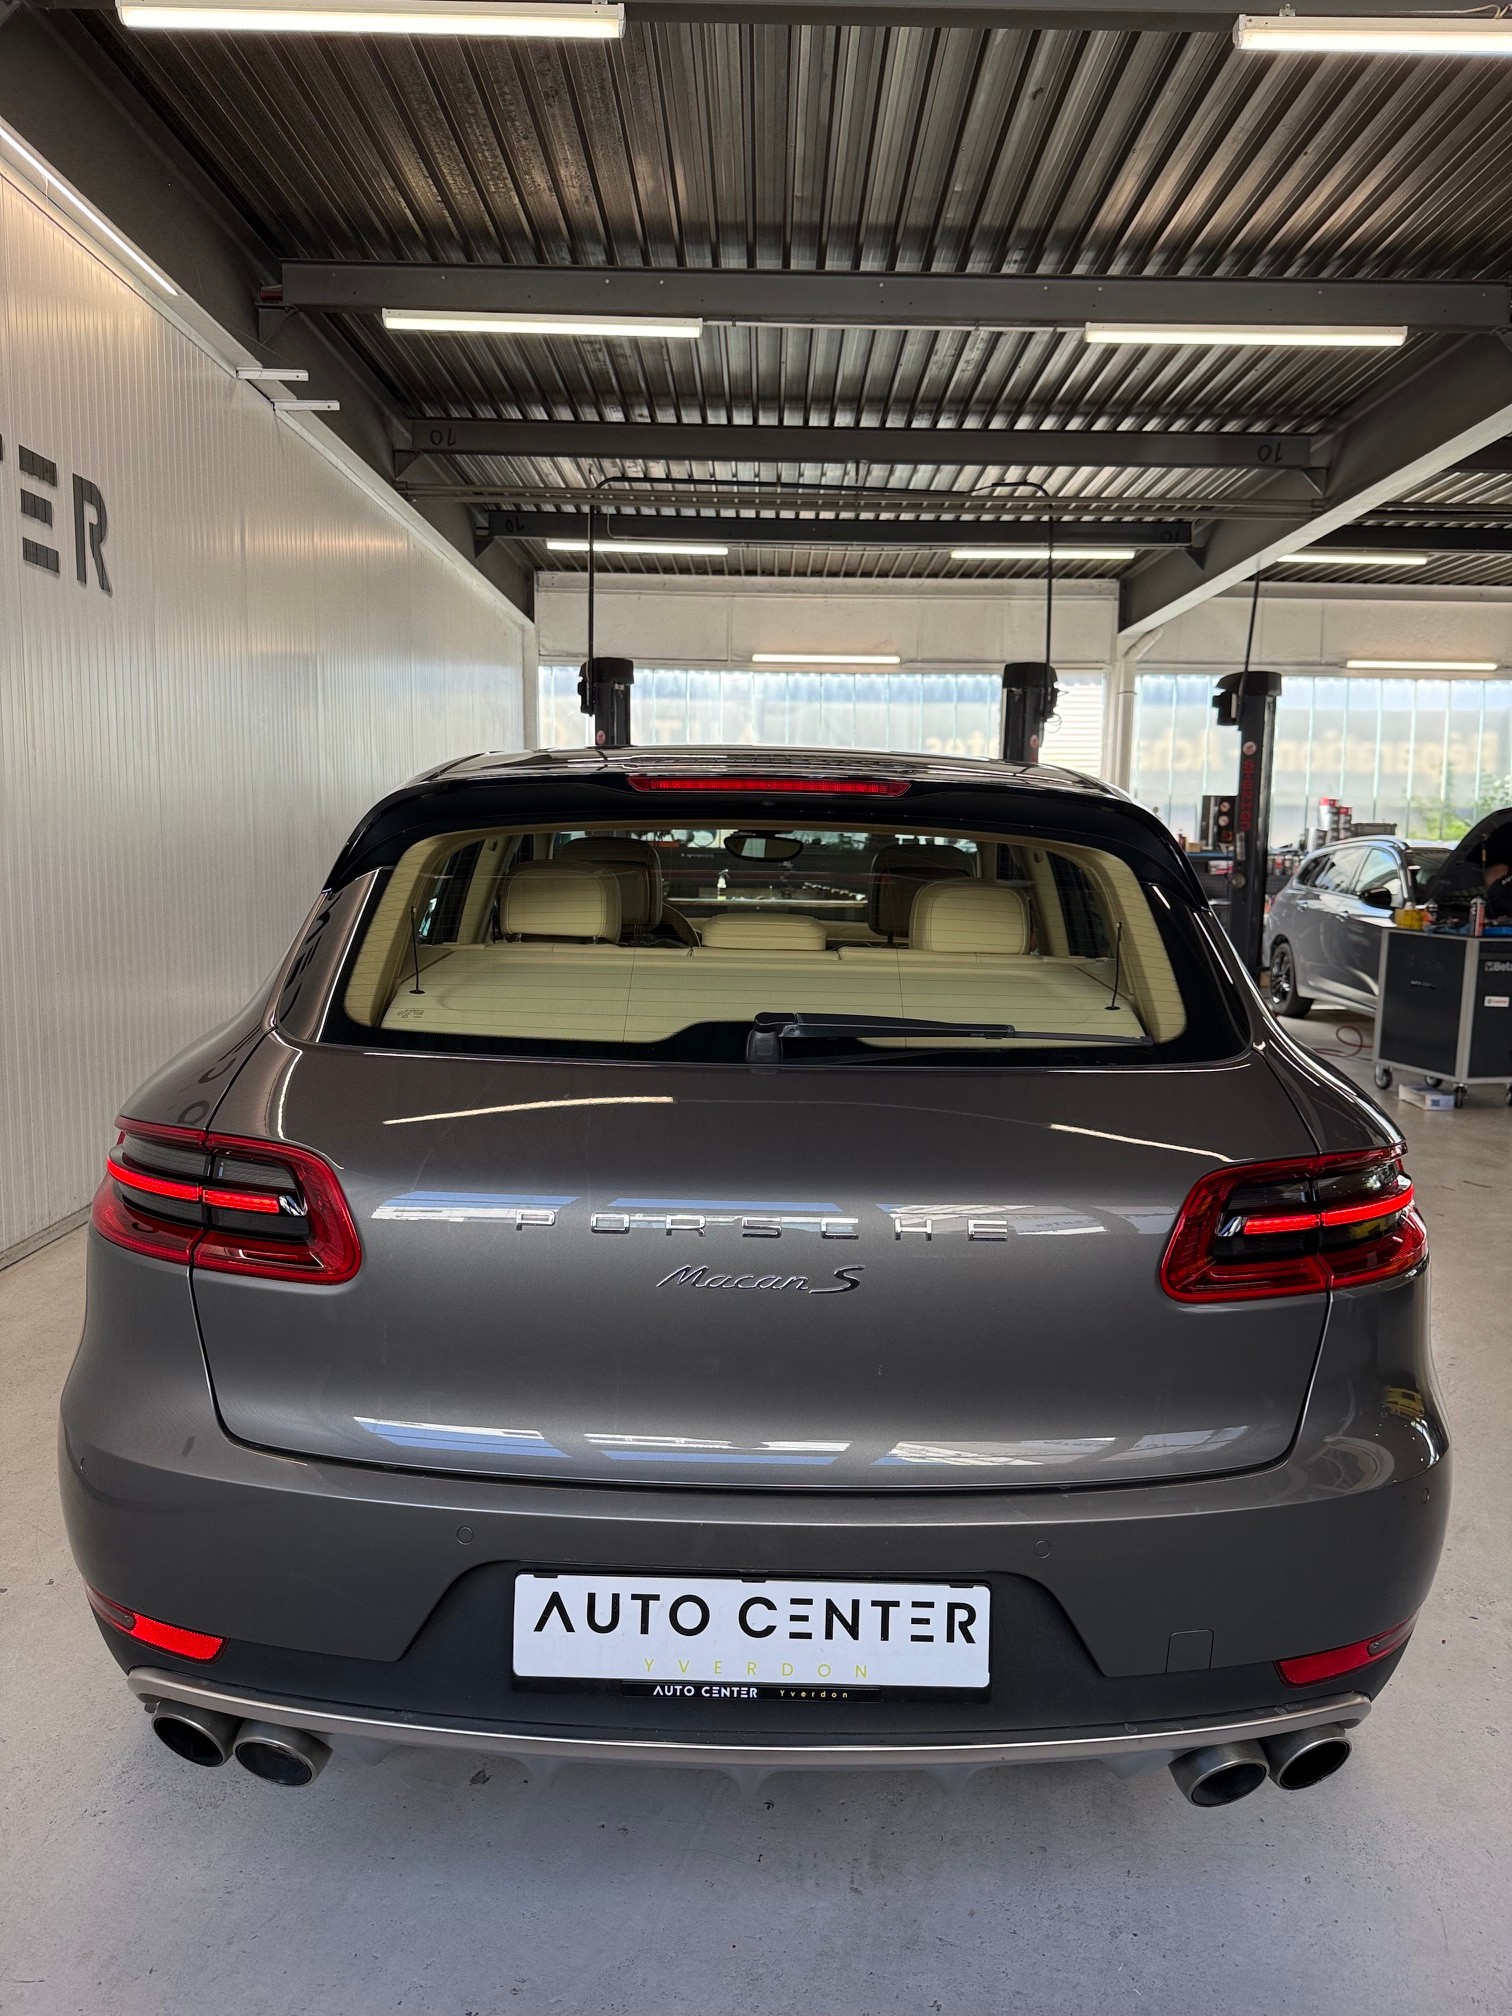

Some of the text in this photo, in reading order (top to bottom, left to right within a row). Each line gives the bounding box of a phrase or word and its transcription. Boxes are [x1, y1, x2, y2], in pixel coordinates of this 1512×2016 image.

[0, 433, 111, 592] ER
[515, 1209, 1008, 1242] PORSCHE
[656, 1264, 866, 1294] Macan S
[533, 1590, 977, 1644] AUTO CENTER
[643, 1658, 867, 1679] YVERDON
[653, 1684, 850, 1699] AUTO CENTER Yverdon
